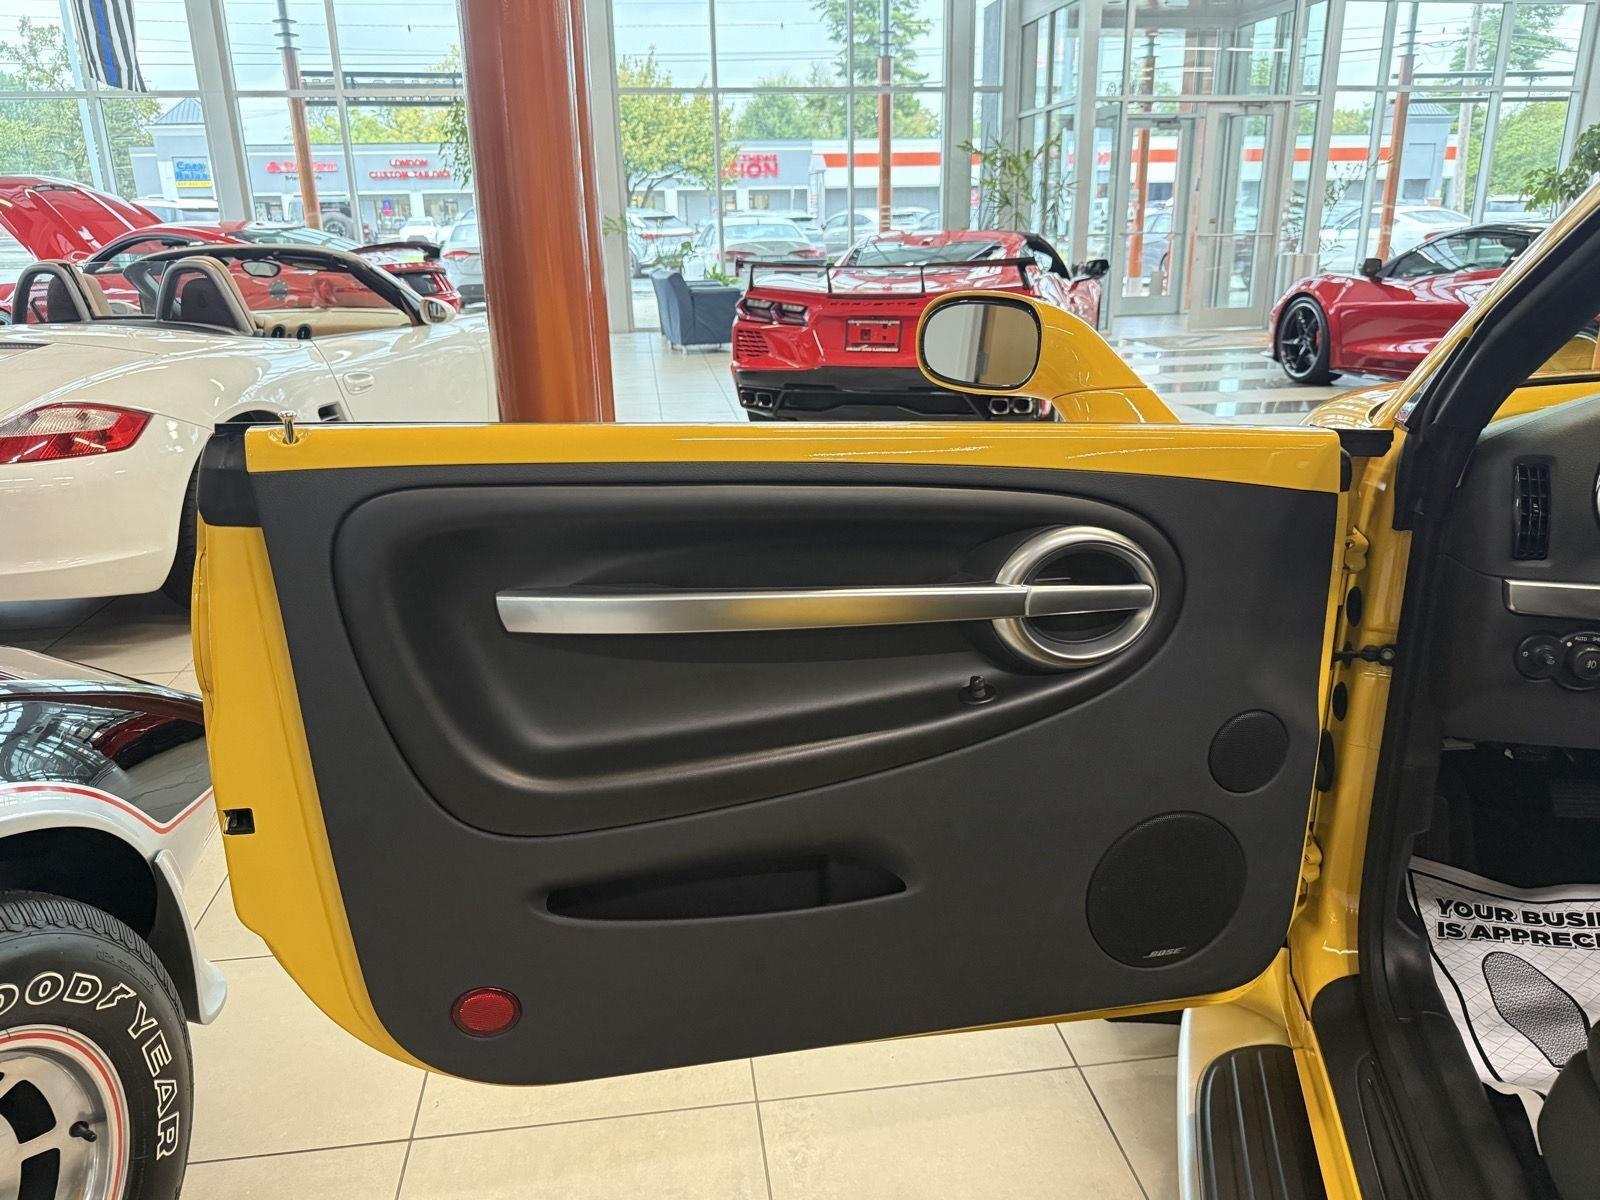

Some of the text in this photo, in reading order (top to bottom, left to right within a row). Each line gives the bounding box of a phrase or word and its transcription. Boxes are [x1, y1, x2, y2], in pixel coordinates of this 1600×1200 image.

[1436, 898, 1517, 923] YOUR
[1437, 921, 1466, 938] IS
[1142, 946, 1187, 959] BOSE
